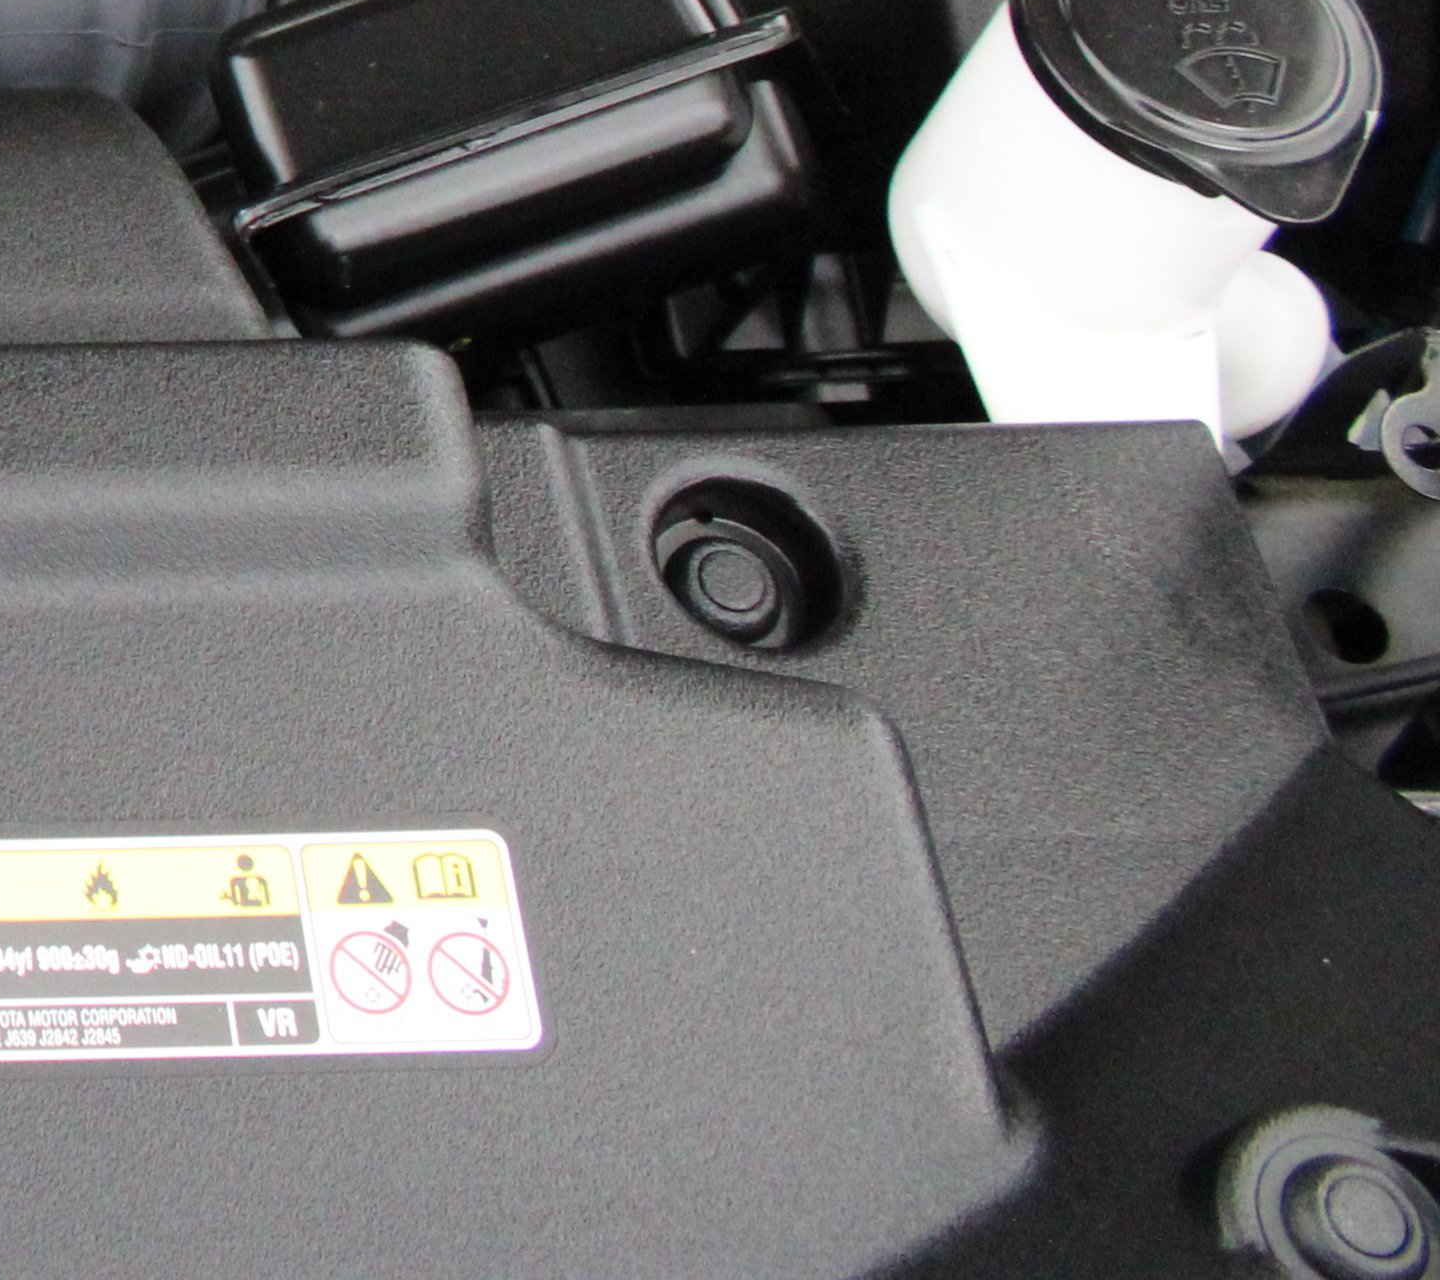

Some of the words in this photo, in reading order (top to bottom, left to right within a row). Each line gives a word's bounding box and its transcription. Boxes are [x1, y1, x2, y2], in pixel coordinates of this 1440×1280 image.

[249, 941, 300, 972] (POE)
[28, 1008, 78, 1027] MOTOR
[80, 1006, 177, 1027] CORPORATION
[257, 1007, 298, 1038] VR
[4, 1029, 36, 1048] J639
[81, 1027, 121, 1046] J2845
